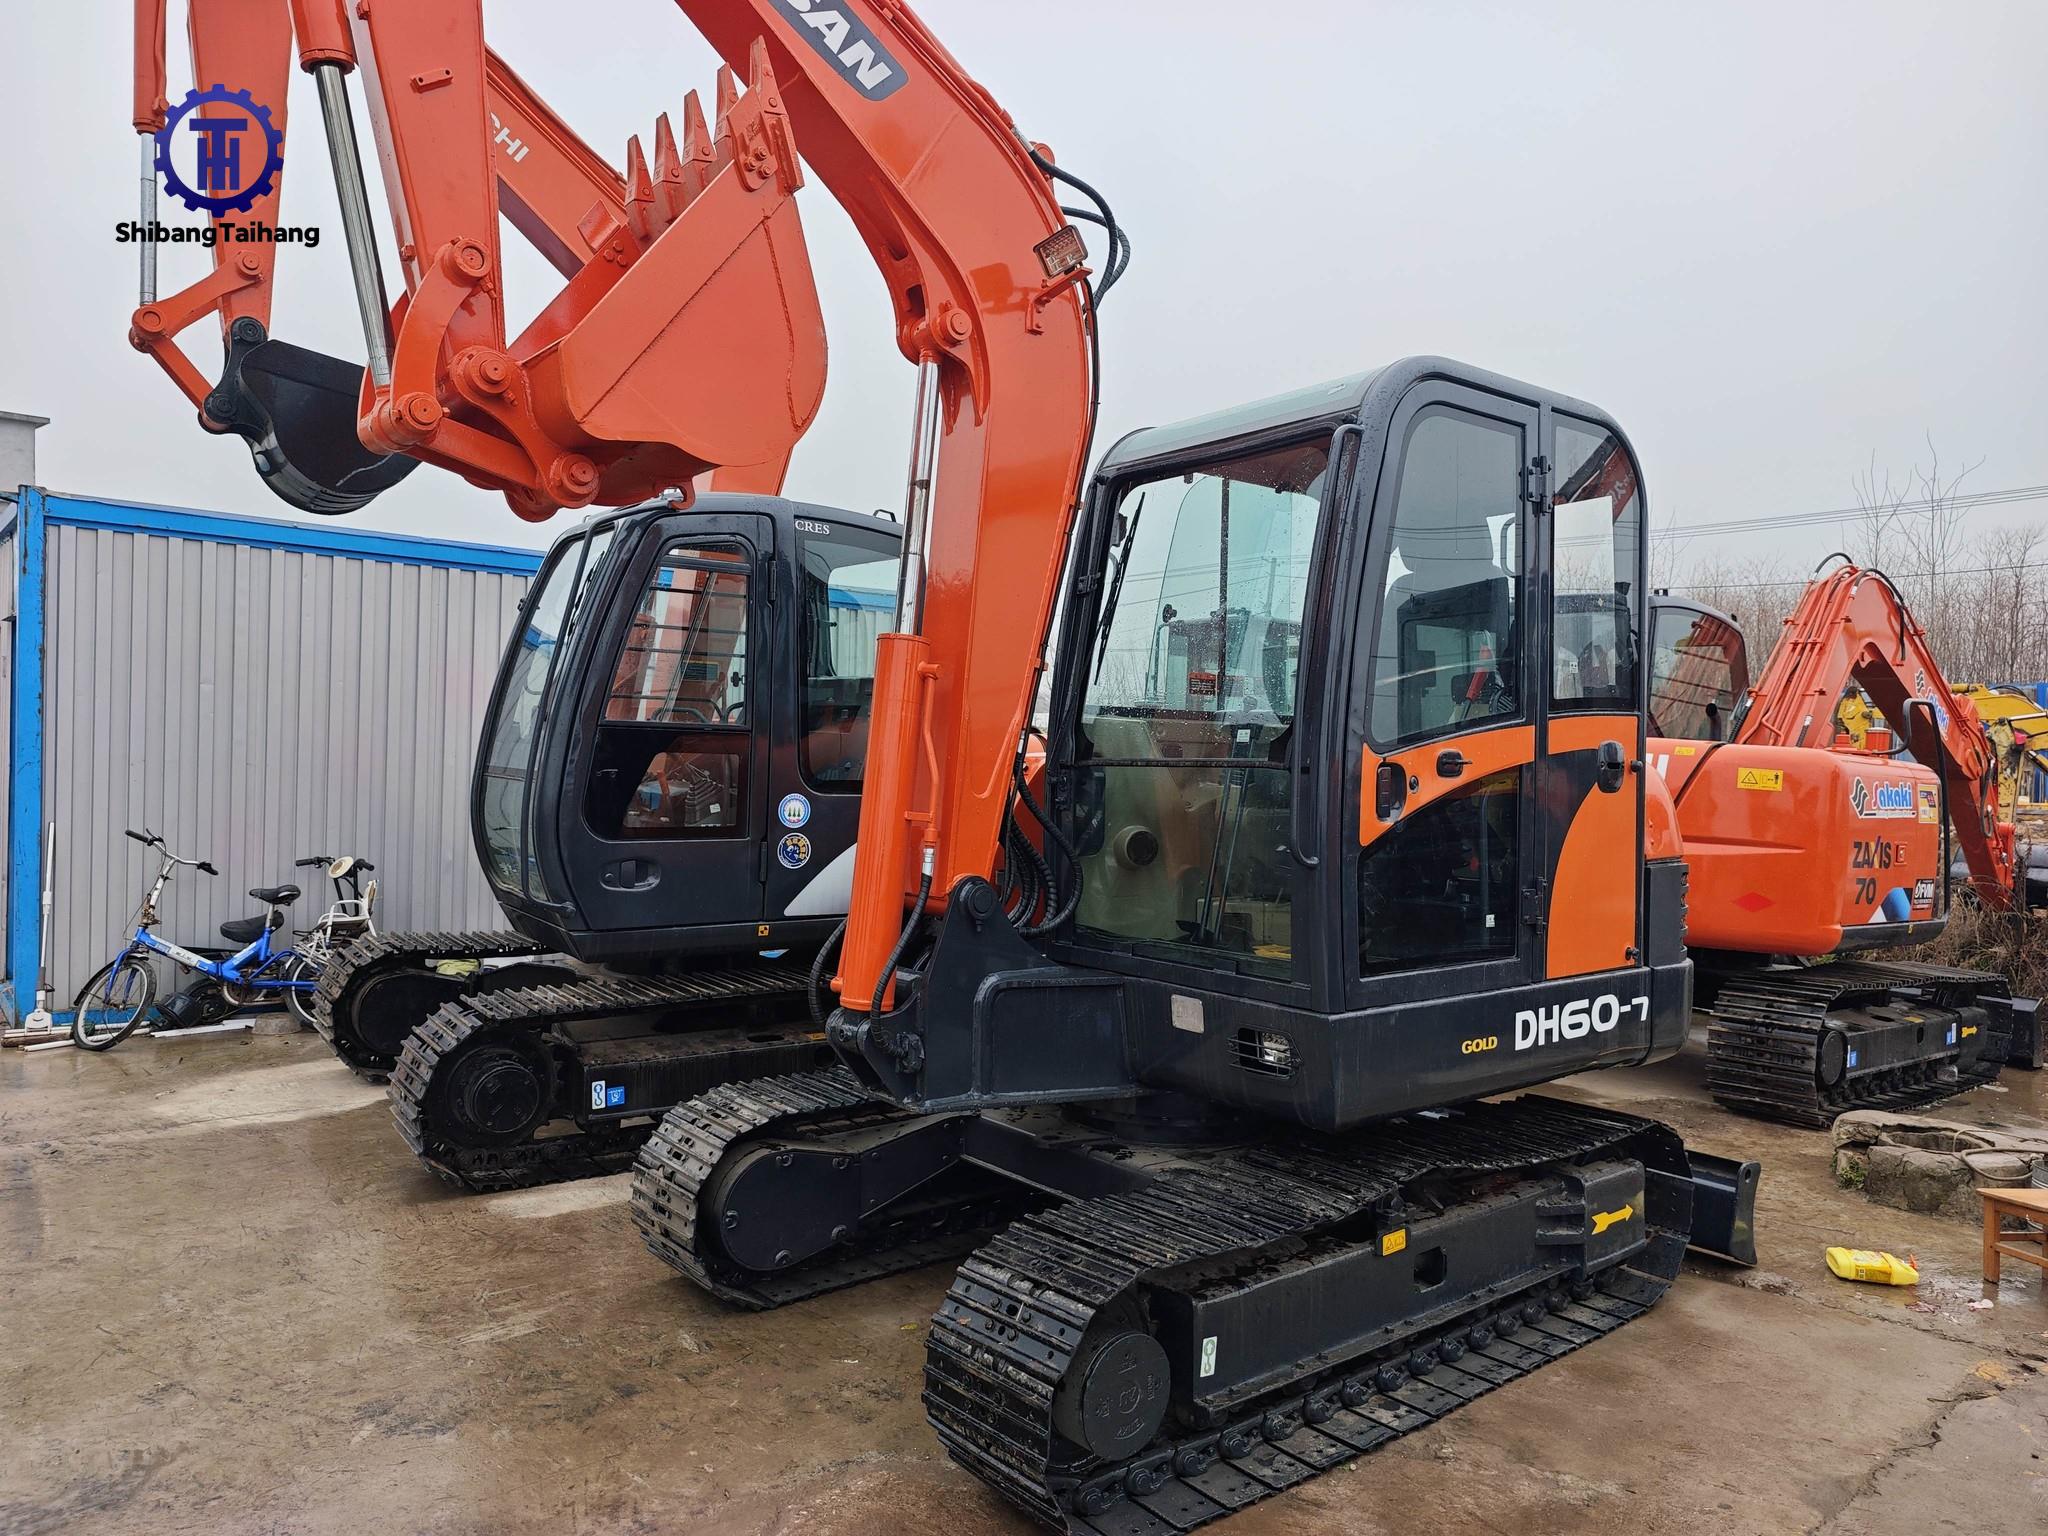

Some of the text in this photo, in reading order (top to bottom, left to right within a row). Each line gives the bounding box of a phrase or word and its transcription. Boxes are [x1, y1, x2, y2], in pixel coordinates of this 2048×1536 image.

[795, 520, 830, 535] CRES
[1855, 877, 1877, 905] 70
[1515, 994, 1649, 1051] DH60-7
[1461, 1036, 1498, 1054] GOLD
